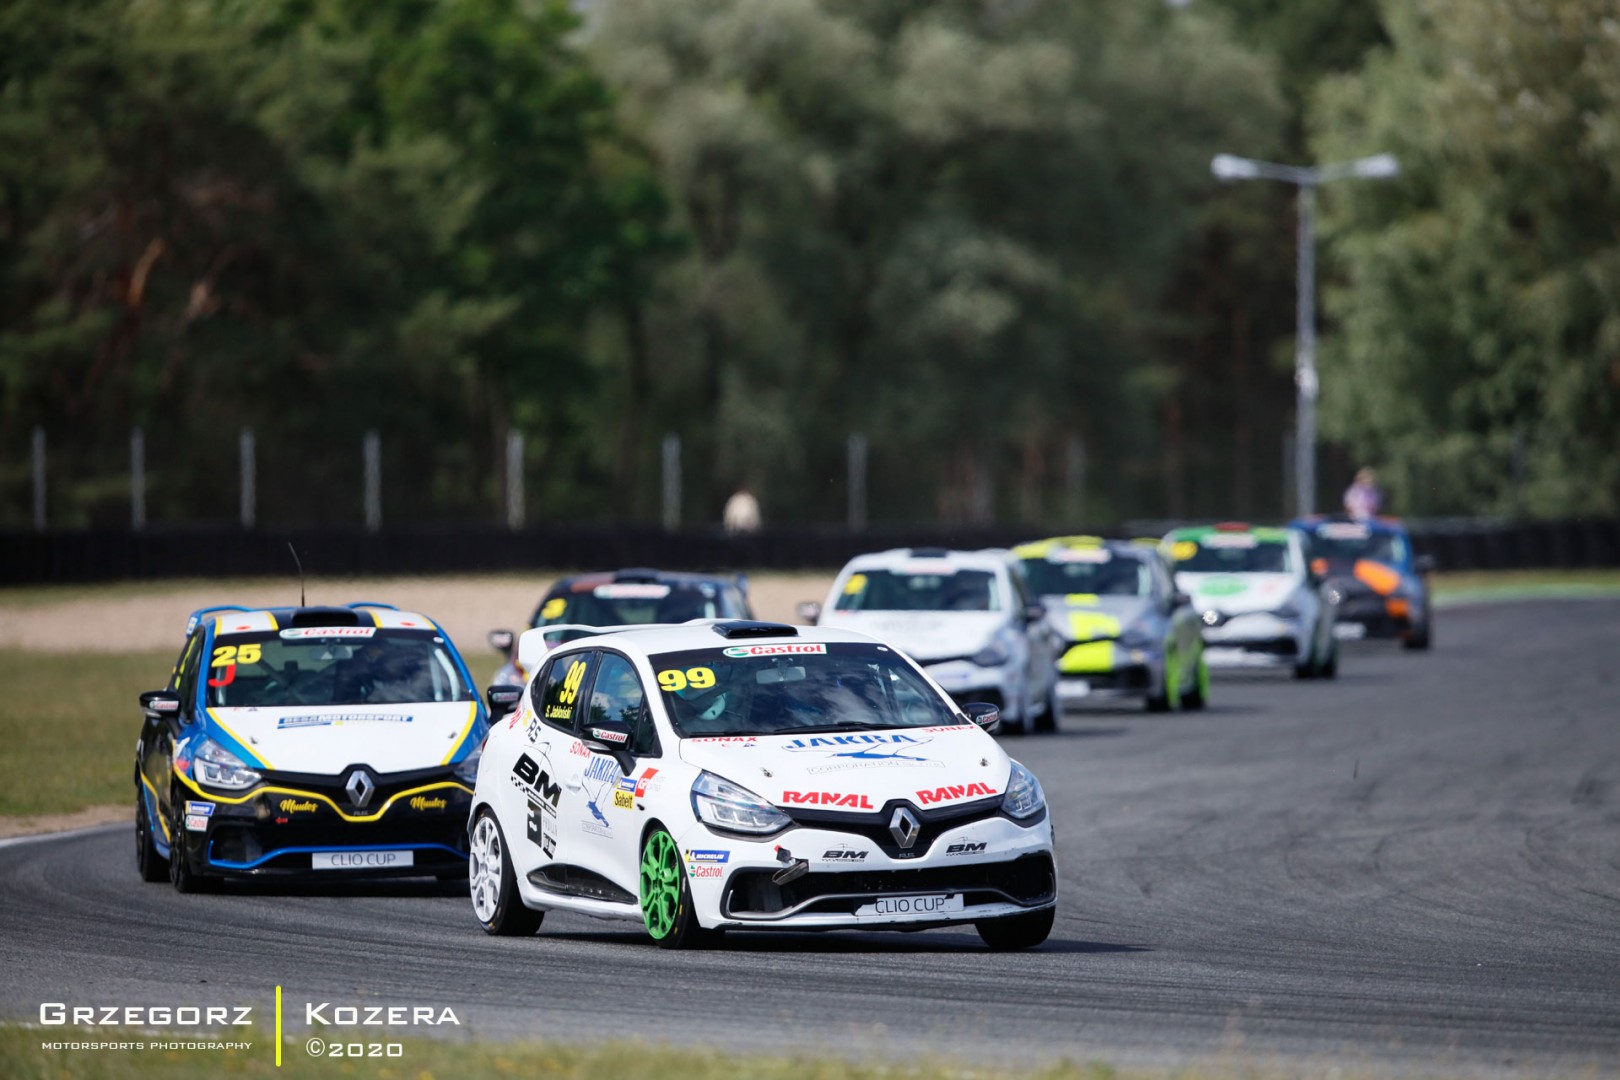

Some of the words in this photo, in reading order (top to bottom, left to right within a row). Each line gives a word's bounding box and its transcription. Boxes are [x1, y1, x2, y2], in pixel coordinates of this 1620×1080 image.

[303, 626, 373, 637] Castrol
[211, 643, 262, 667] 25
[750, 644, 823, 655] Castrol
[559, 660, 587, 704] 99
[657, 667, 716, 691] 99
[600, 731, 627, 741] Castrol
[785, 734, 919, 749] JAKRA
[584, 756, 622, 784] JAKRA
[512, 752, 562, 808] BM
[614, 791, 633, 809] Sabelt
[782, 790, 874, 809] RANAL
[915, 782, 997, 804] RANAL
[822, 850, 870, 859] BM
[946, 842, 988, 854] BM
[331, 854, 363, 867] CLIO
[366, 853, 396, 866] CUP
[695, 865, 723, 878] Castrol
[875, 899, 910, 914] CLIO
[913, 897, 945, 912] CUP
